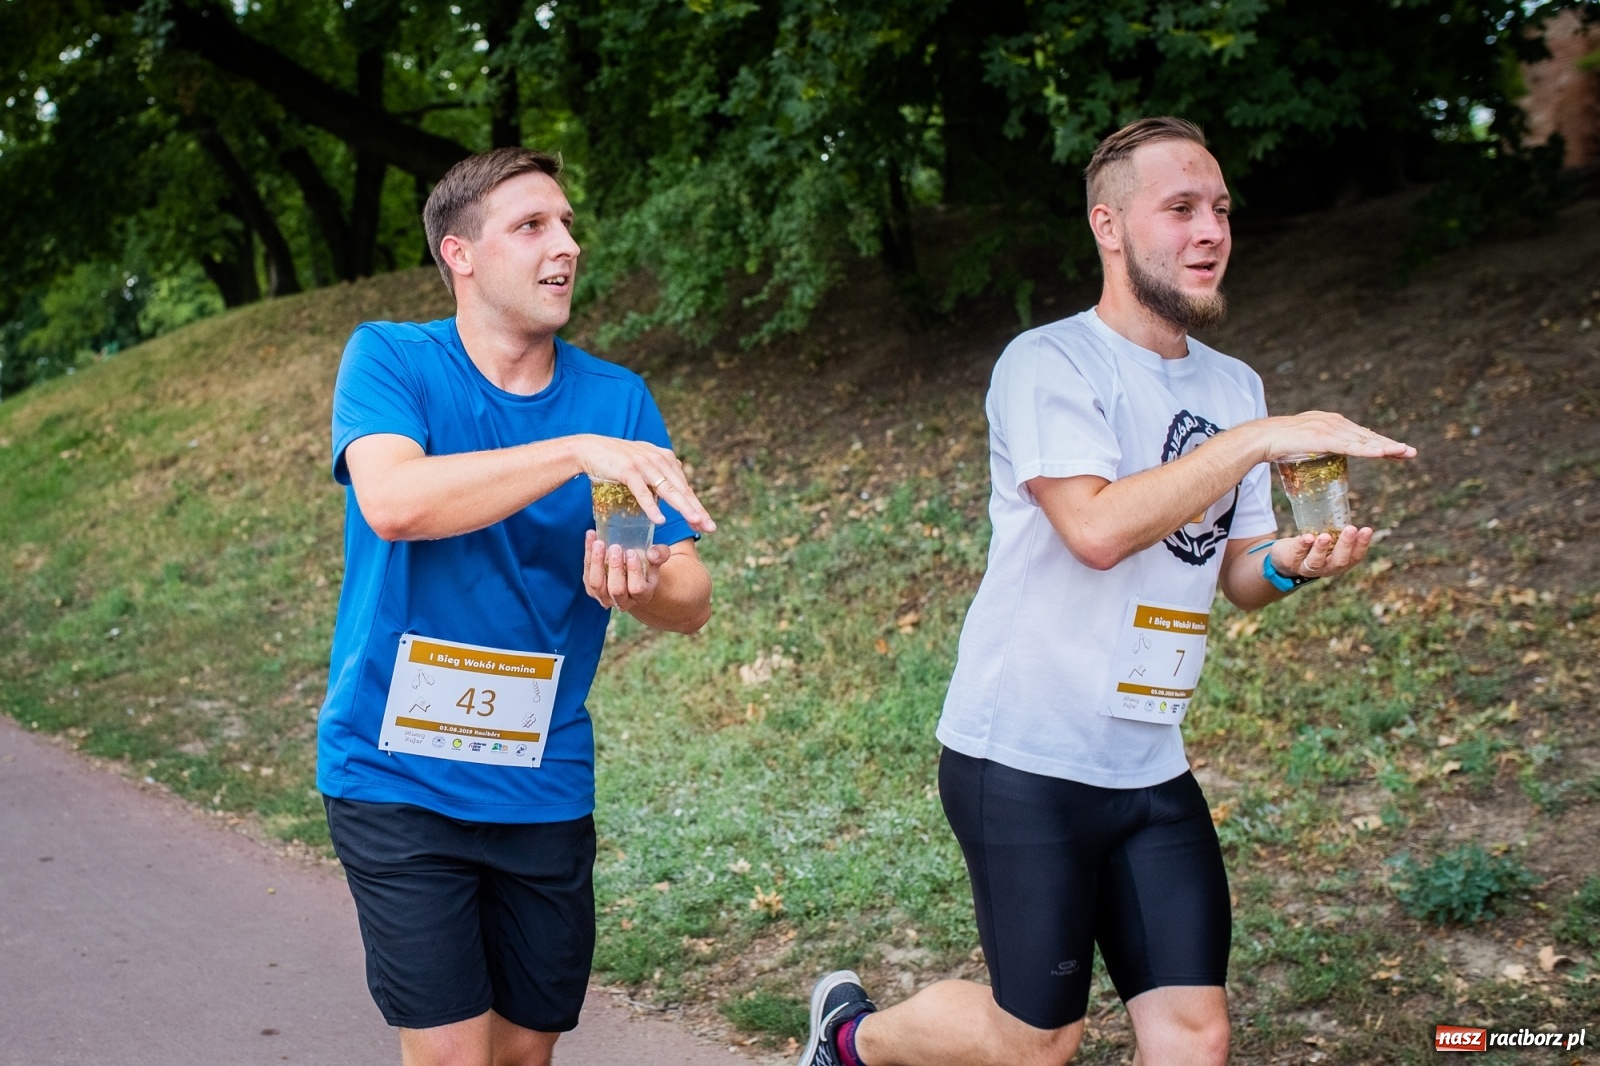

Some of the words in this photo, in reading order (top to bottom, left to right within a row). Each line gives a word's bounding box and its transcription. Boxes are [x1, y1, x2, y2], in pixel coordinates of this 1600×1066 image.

[1154, 616, 1171, 629] Bieg
[429, 652, 434, 661] I
[437, 654, 460, 667] Bieg
[464, 658, 496, 670] Wokół
[498, 663, 536, 674] Komina
[1173, 649, 1186, 677] 7
[456, 687, 497, 717] 43
[439, 725, 473, 735] 03.08.2019
